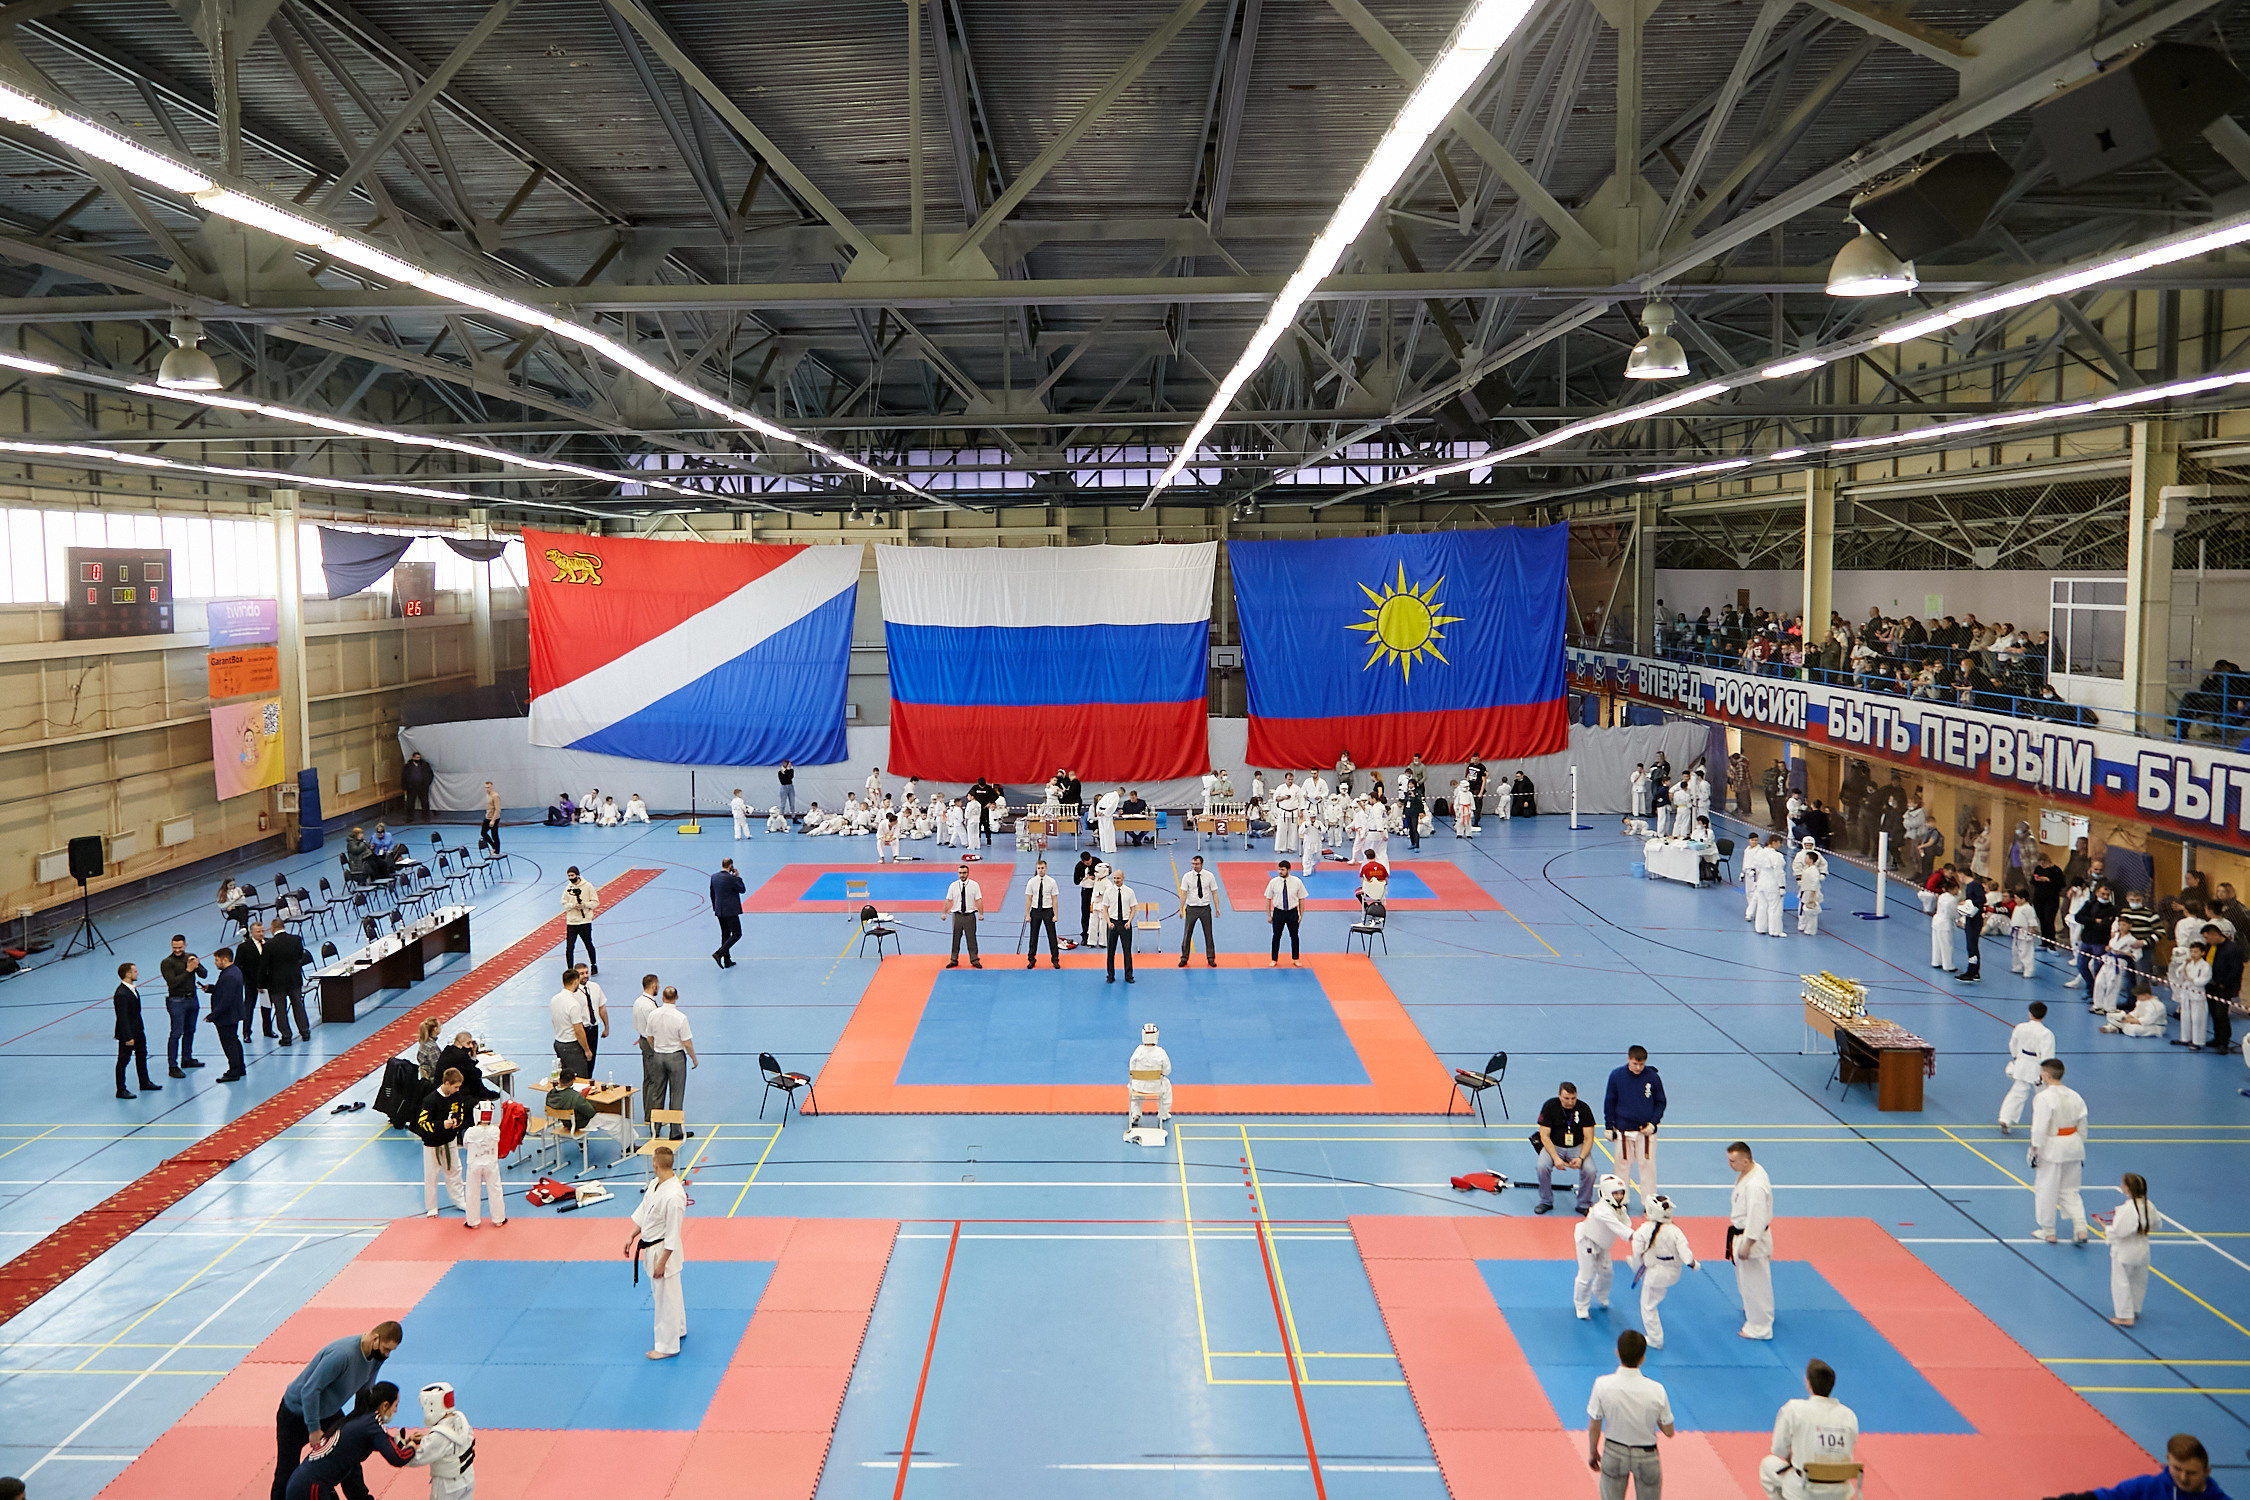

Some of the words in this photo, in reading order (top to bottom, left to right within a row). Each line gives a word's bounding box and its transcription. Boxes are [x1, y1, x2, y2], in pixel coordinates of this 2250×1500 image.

[211, 656, 243, 666] GarantBox
[1638, 663, 1705, 714] ВПЕРЁД,
[1714, 678, 1807, 730] РОССИЯ!
[1827, 696, 1910, 752] БЫТЬ
[1920, 714, 2092, 796] ПЕРВЫМ
[1217, 823, 1226, 831] 2
[1818, 1433, 1845, 1448] 104
